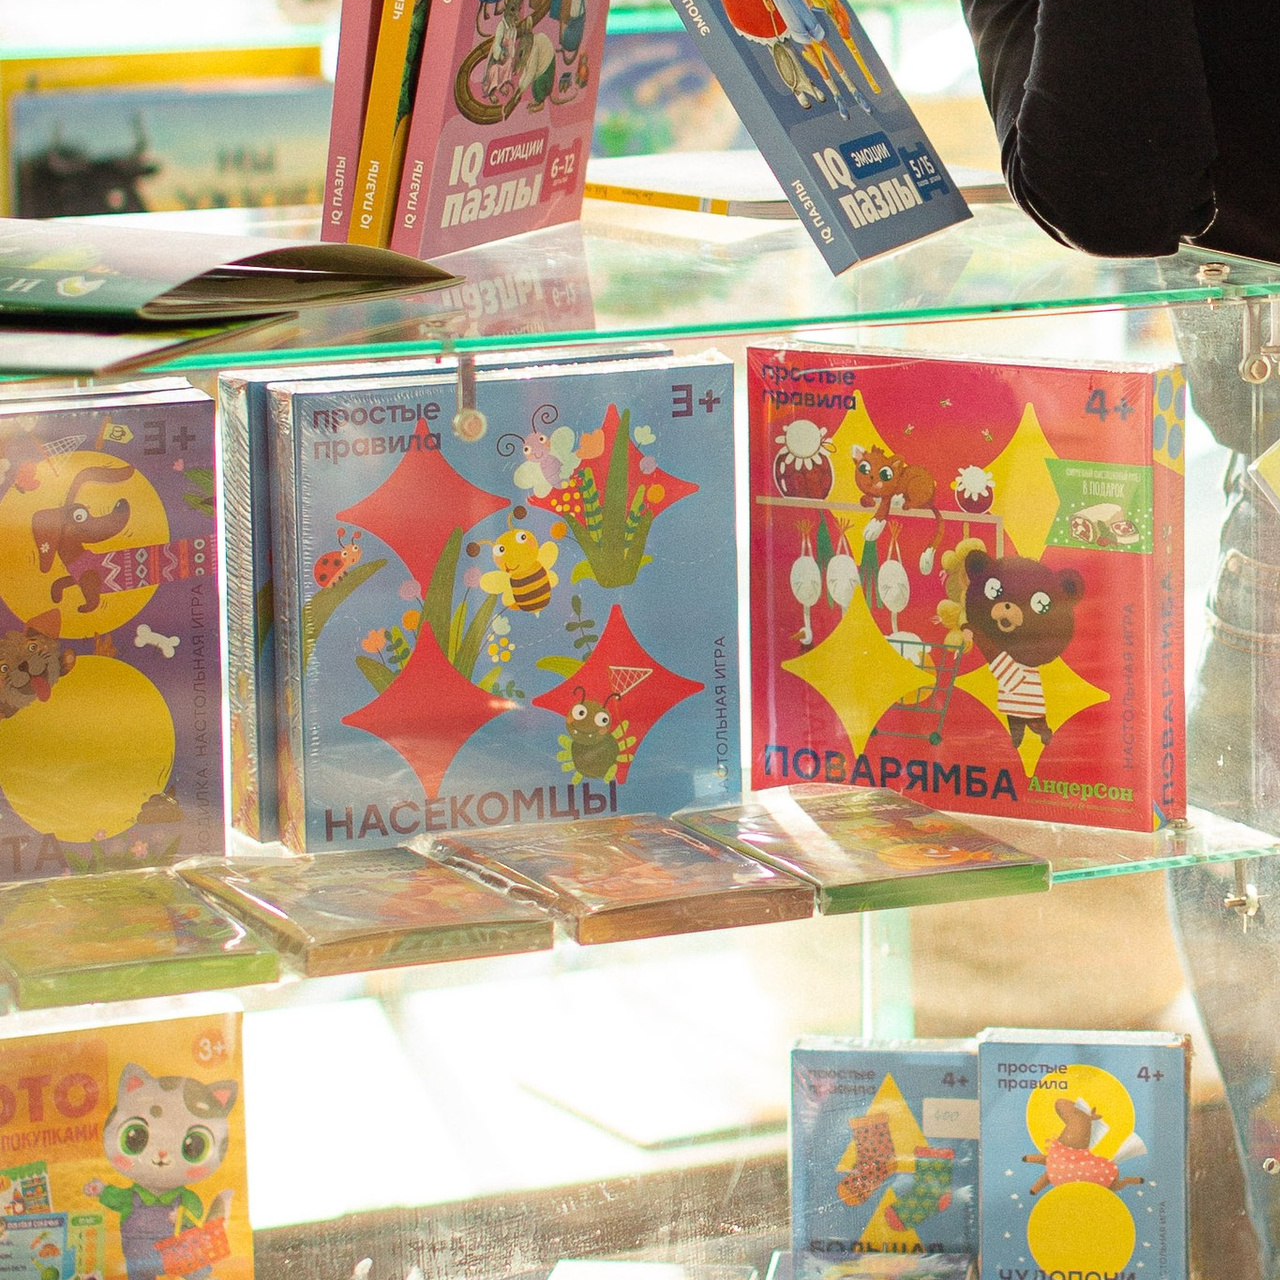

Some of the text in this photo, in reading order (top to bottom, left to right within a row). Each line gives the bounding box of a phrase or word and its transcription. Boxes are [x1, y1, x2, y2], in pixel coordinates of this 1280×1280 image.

[449, 141, 485, 188] IQ
[489, 138, 545, 167] СИТУАЦИИ
[812, 147, 857, 190] IQ
[851, 142, 891, 168] ЭМОЦИИ
[909, 156, 934, 178] 5/15
[330, 155, 347, 226] IQ ПАЗЛЫ
[359, 159, 380, 229] IQ ПАЗЛЫ
[404, 159, 425, 229] IQ ПАЗЛЫ
[440, 173, 543, 229] пазлы
[838, 173, 923, 229] пазлы
[791, 179, 835, 245] IQ ПАЗЛЫ
[761, 363, 856, 386] простые
[313, 400, 441, 433] простые
[761, 388, 857, 411] правила
[1085, 389, 1135, 423] 4+
[313, 430, 442, 464] правила
[189, 583, 204, 628] ИГРА
[190, 635, 210, 757] НАСТОЛЬНАЯ
[1122, 603, 1134, 770] НАСТОЛЬНАЯ ИГРА
[714, 635, 729, 798] АСТОЛЬНАЯ ИГРА
[764, 744, 1018, 802] ПОВАРЯМБА
[325, 781, 618, 842] НАСЕКОМЦЫ
[198, 1038, 226, 1061] 3+
[943, 1072, 969, 1087] 4+
[998, 1062, 1068, 1076] простые
[998, 1078, 1068, 1092] правила
[1137, 1066, 1165, 1082] 4+
[1, 1123, 99, 1152] ПОКУПКАМИ
